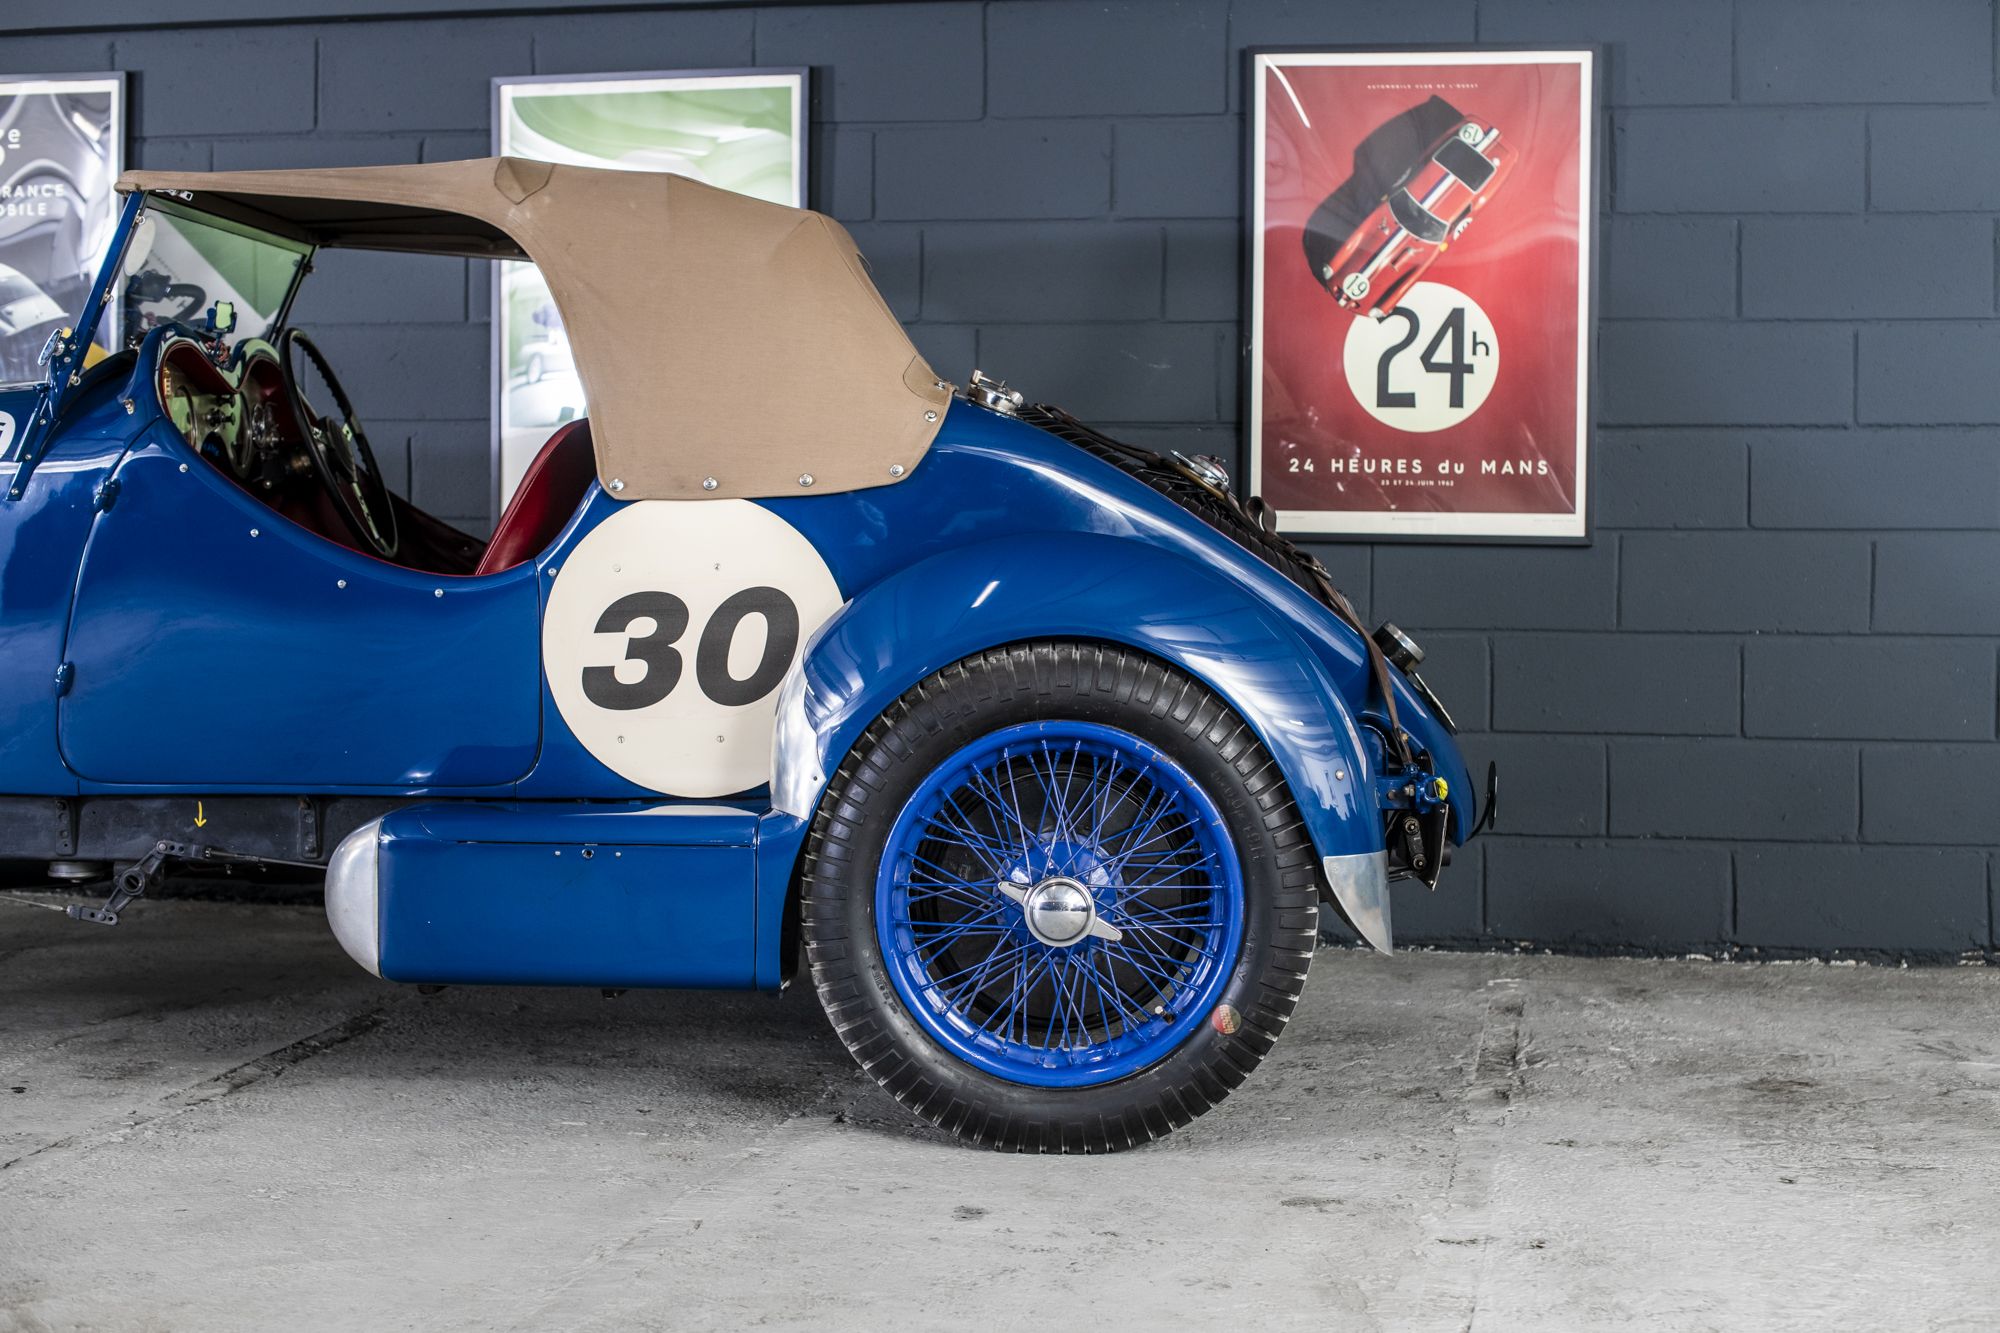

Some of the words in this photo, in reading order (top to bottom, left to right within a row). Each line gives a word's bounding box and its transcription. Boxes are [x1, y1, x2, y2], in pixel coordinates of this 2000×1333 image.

[2, 184, 64, 198] RANCE
[1289, 458, 1314, 473] 24
[1331, 458, 1423, 474] HEURES
[1438, 459, 1465, 475] du
[1481, 459, 1549, 475] MANS
[1418, 479, 1435, 487] JUIN
[582, 586, 800, 711] 30
